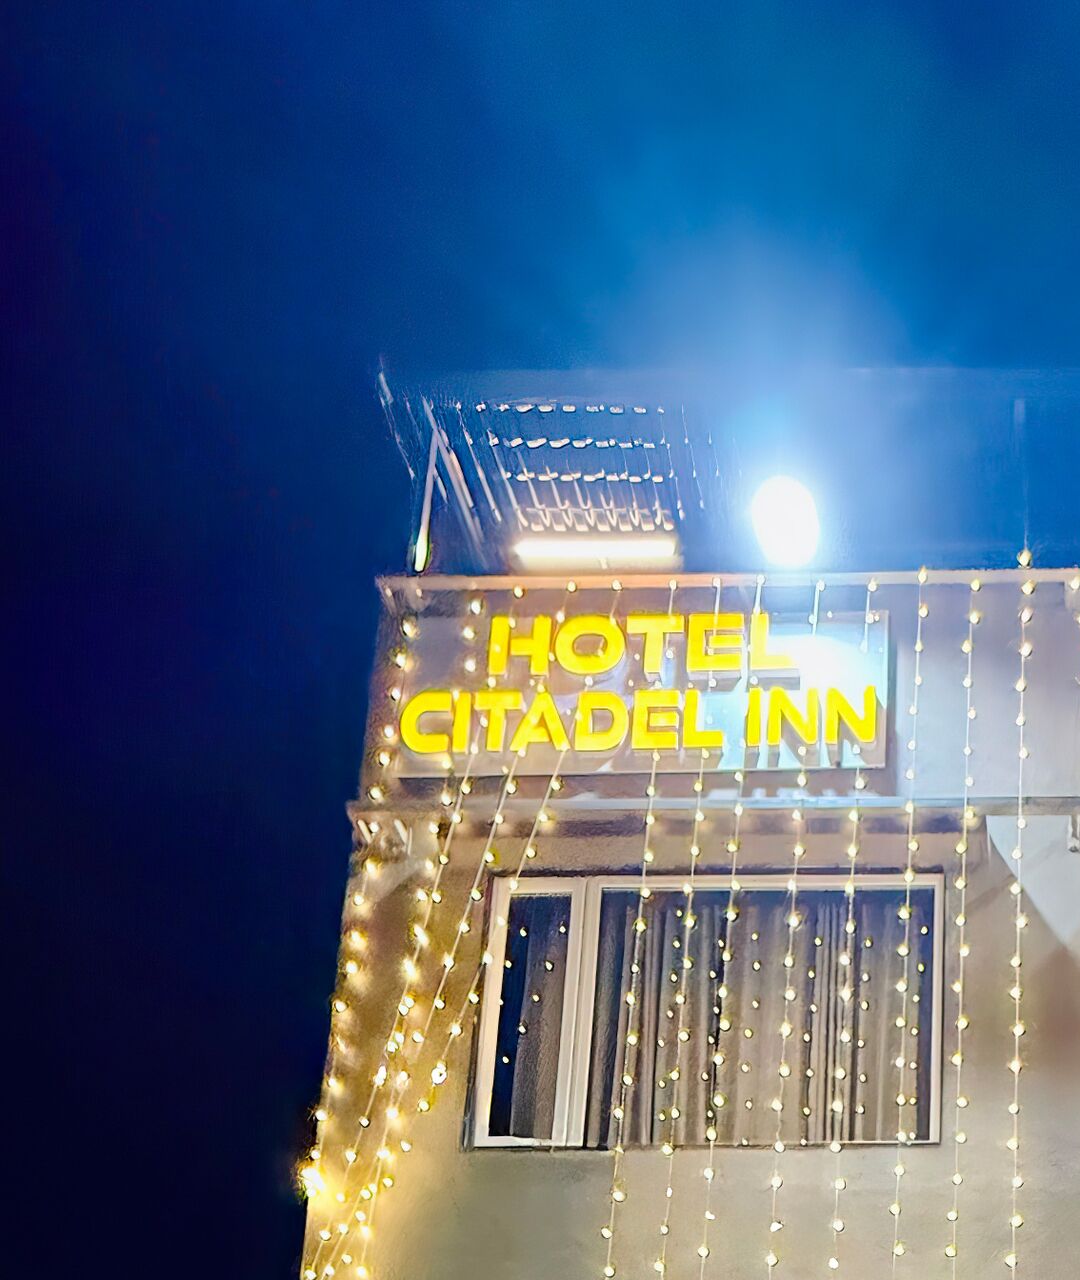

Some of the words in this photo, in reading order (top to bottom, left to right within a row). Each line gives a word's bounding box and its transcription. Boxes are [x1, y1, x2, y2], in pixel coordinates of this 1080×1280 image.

[487, 612, 800, 678] HOTEL
[400, 690, 725, 753] CITADEL
[746, 685, 877, 748] INN
